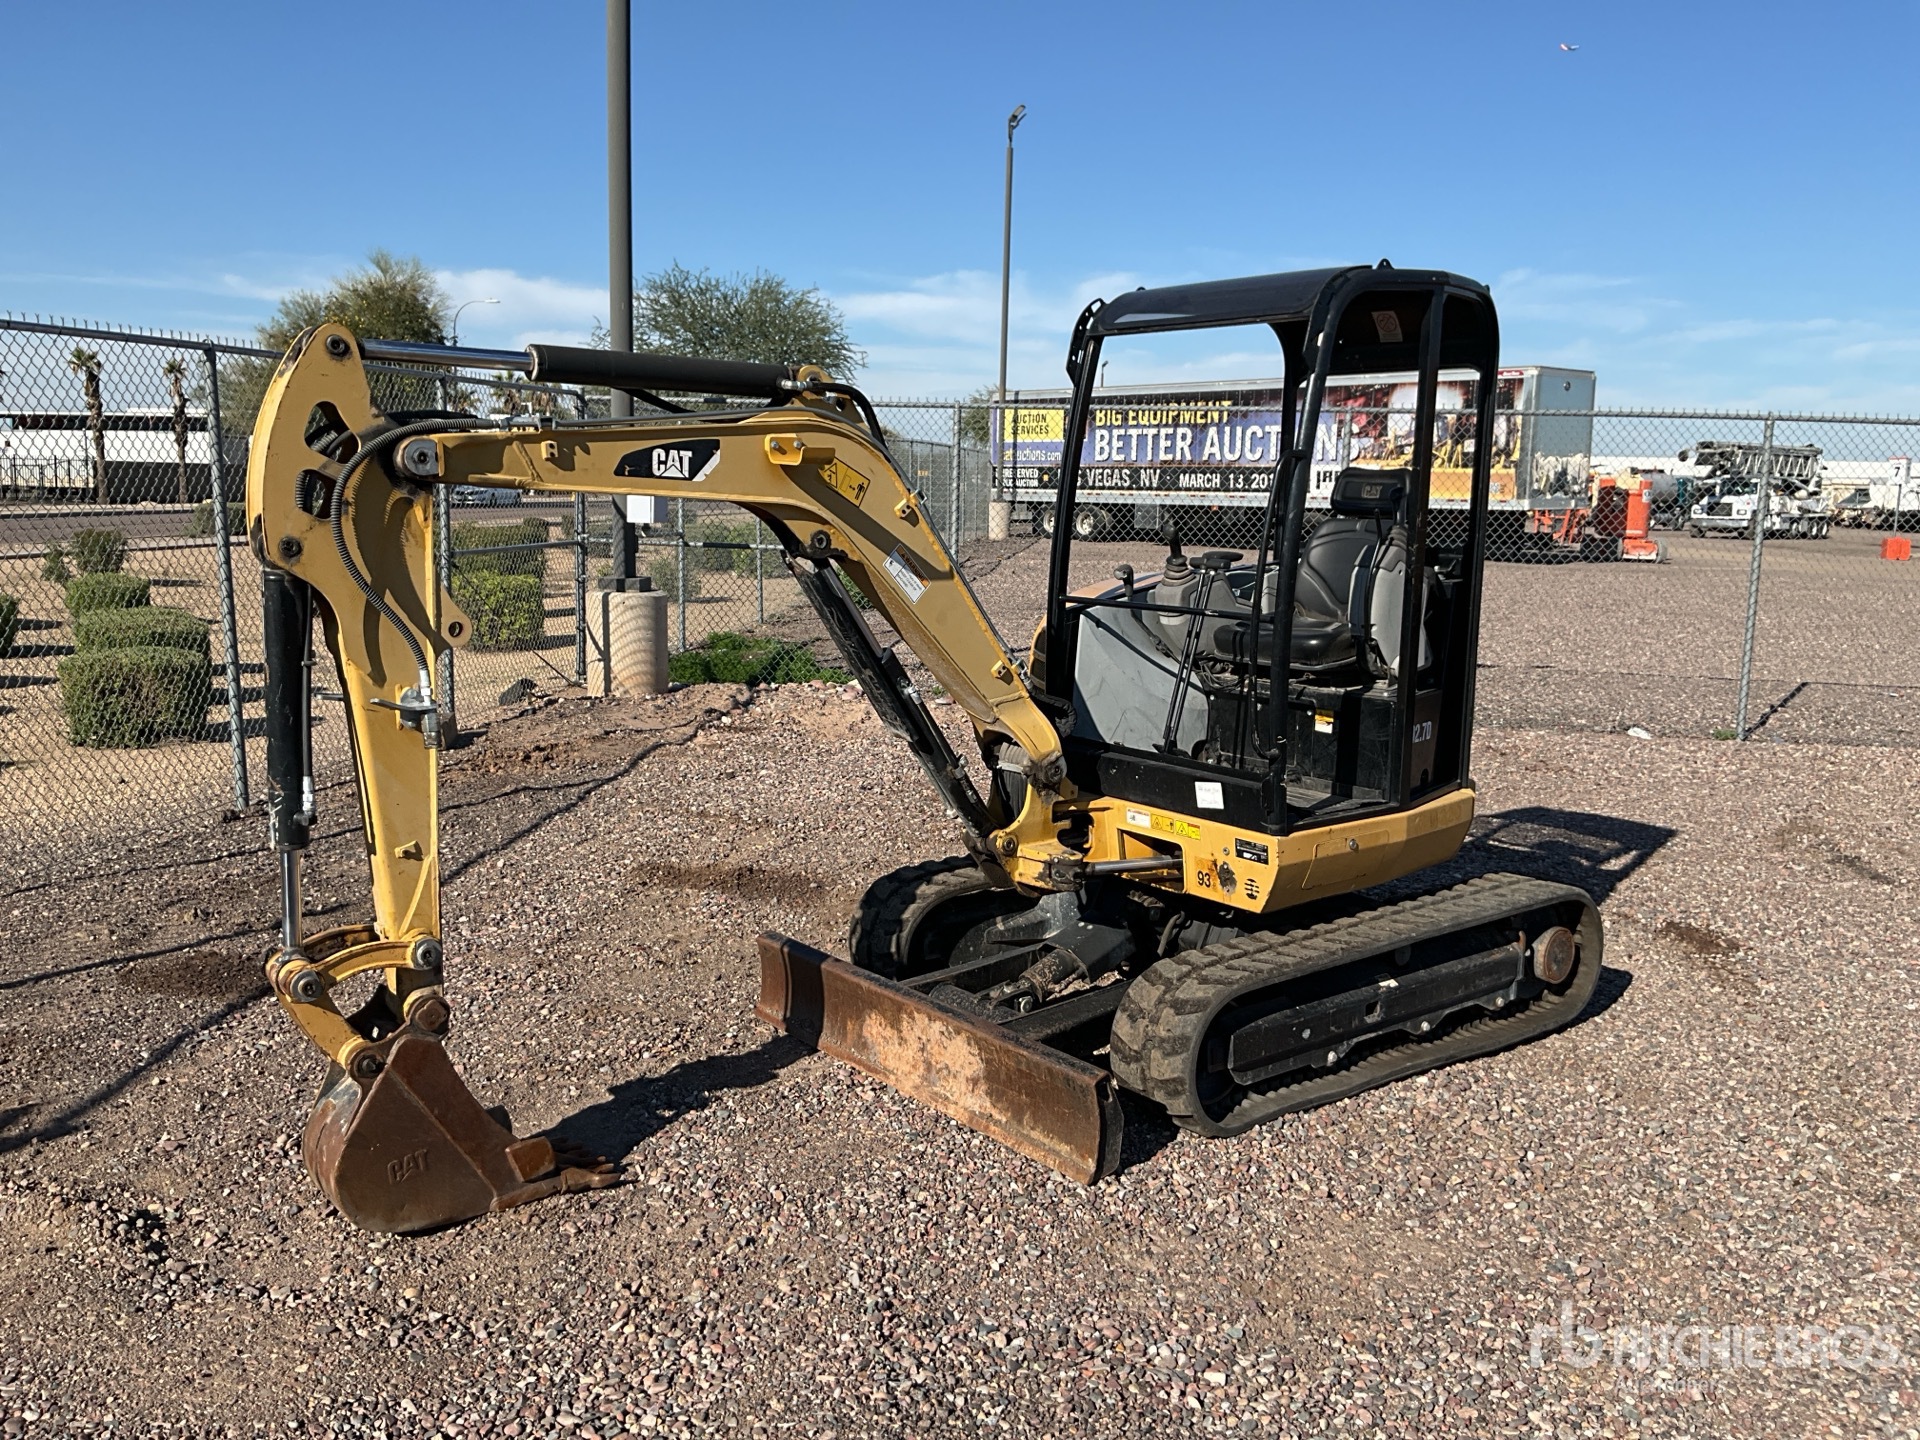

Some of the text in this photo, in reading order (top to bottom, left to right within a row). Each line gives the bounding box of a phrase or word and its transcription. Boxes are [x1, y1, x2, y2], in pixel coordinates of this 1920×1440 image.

[1095, 424, 1361, 461] BETTER AUCTNS
[652, 448, 693, 478] CAT
[1894, 466, 1901, 477] 7
[1140, 468, 1160, 488] NV
[1179, 473, 1221, 488] MARCH
[1363, 484, 1382, 498] CAT
[1197, 870, 1211, 888] 93
[387, 1149, 427, 1184] CAT
